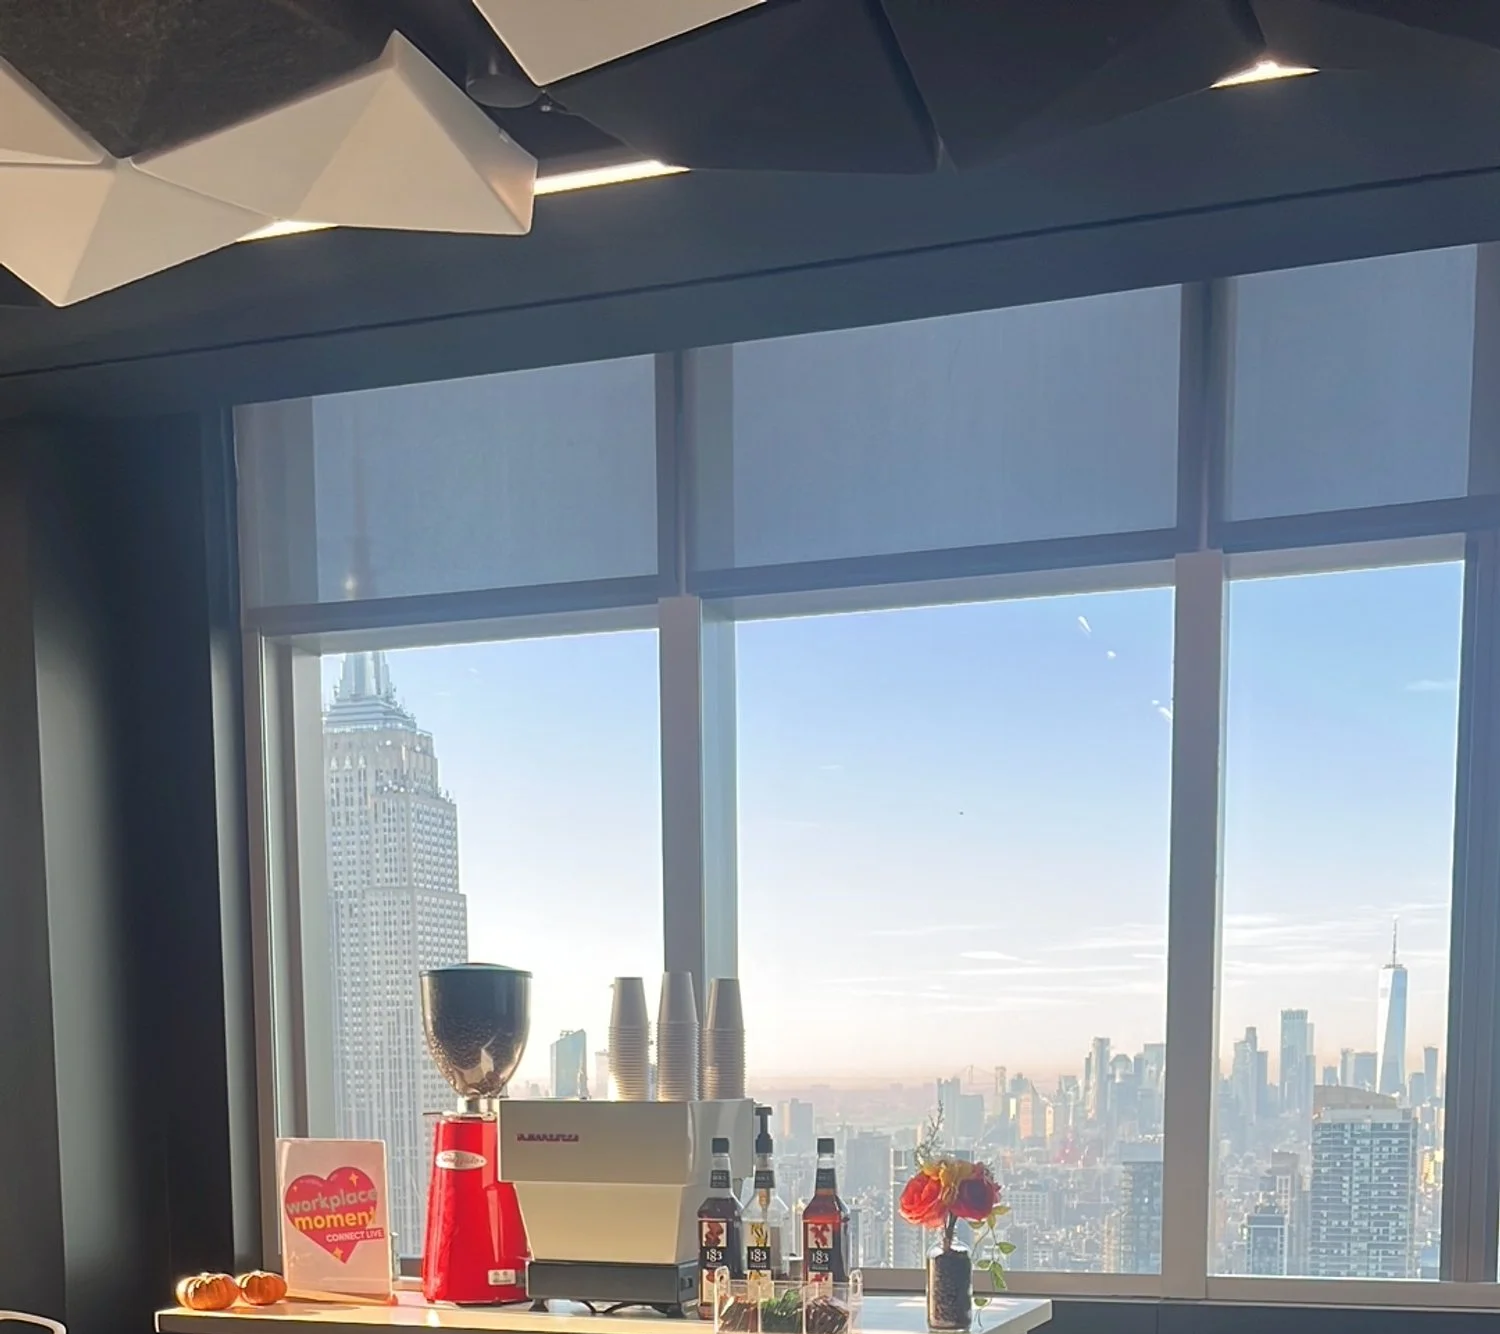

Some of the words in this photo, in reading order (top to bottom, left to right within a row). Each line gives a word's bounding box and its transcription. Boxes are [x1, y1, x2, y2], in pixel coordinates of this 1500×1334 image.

[286, 1188, 378, 1215] workplace
[294, 1206, 377, 1231] moment
[325, 1231, 365, 1242] CONNECT
[366, 1228, 383, 1239] LIVE
